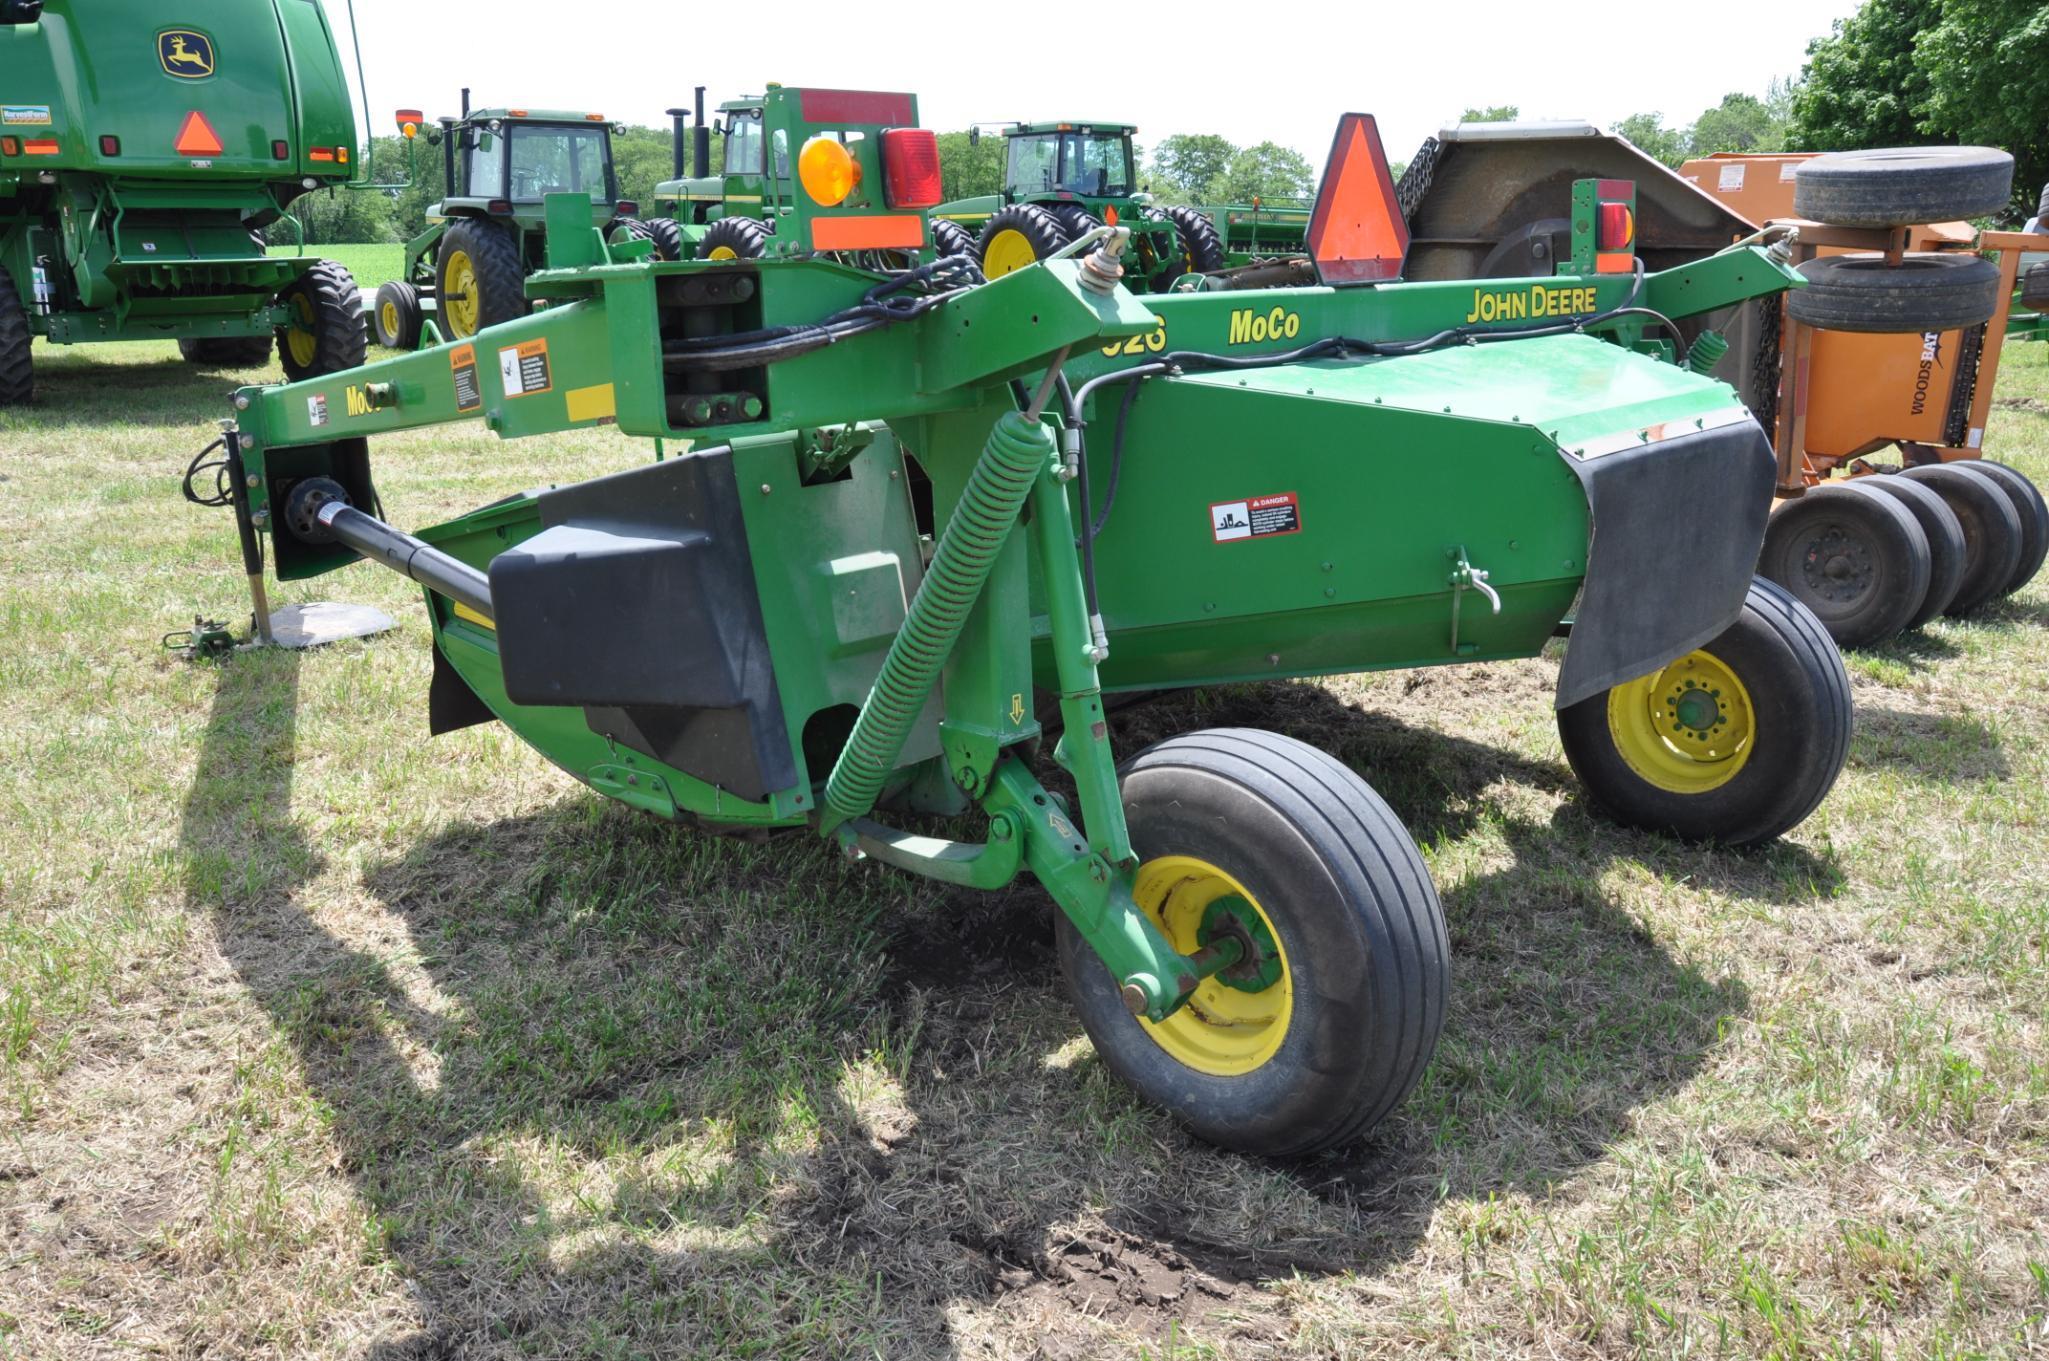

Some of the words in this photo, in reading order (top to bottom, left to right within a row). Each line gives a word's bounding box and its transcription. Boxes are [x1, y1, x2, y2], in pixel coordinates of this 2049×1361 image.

[1467, 288, 1527, 324] JOHN
[1530, 285, 1597, 318] DEERE
[1229, 306, 1300, 345] MoCo
[1260, 496, 1289, 506] DANGER
